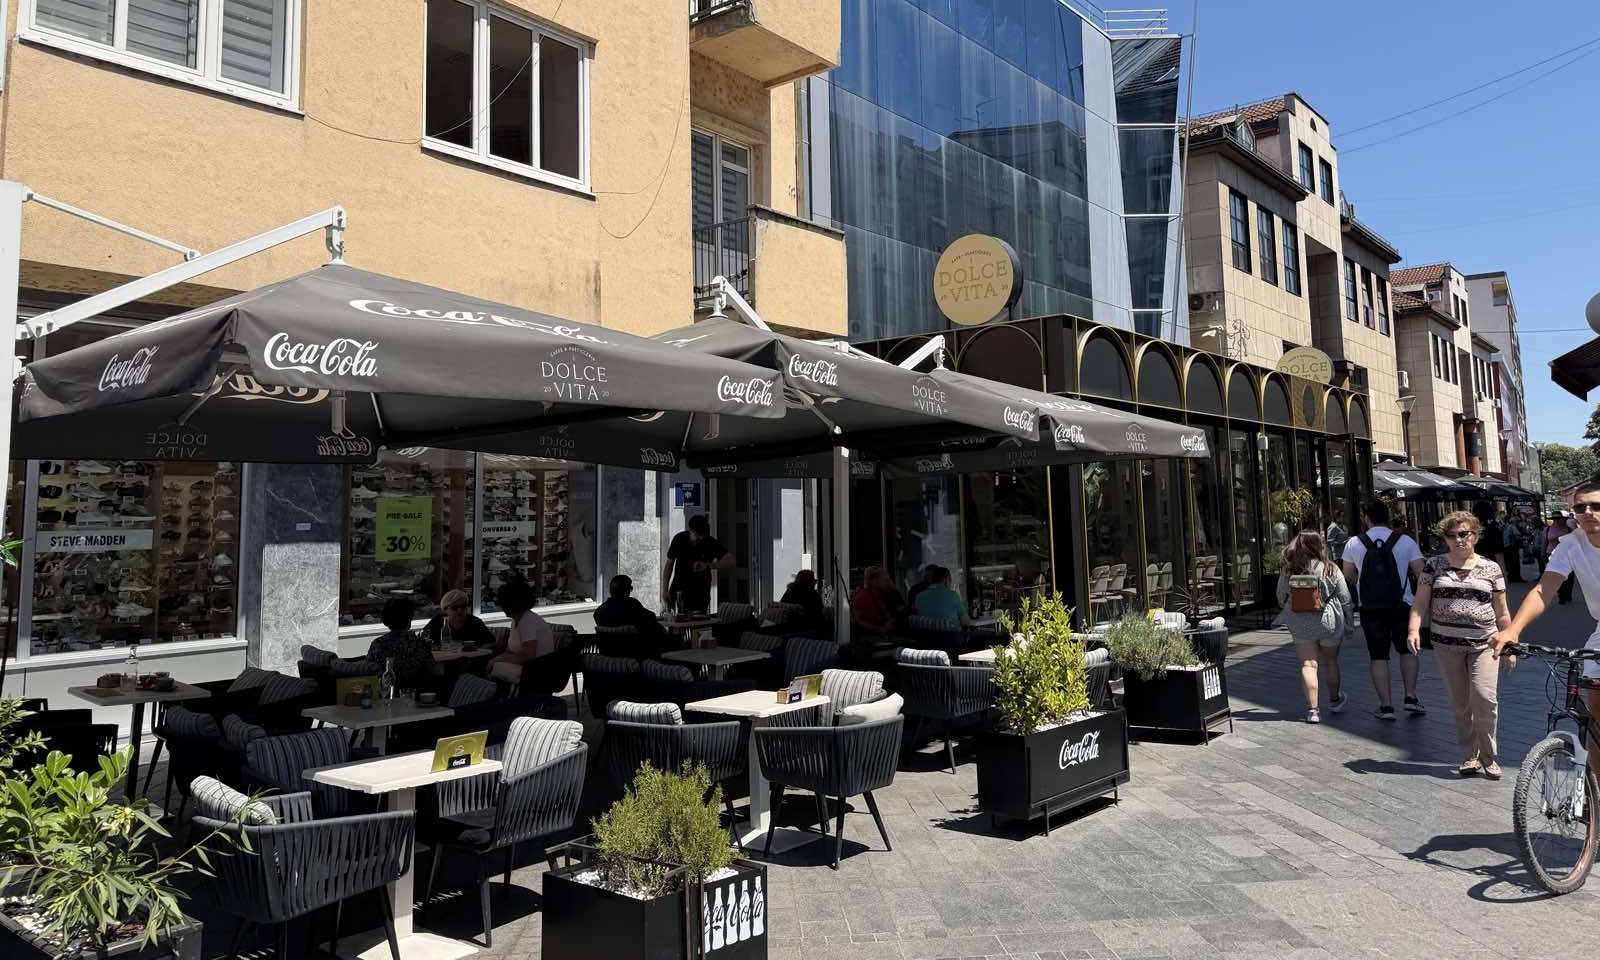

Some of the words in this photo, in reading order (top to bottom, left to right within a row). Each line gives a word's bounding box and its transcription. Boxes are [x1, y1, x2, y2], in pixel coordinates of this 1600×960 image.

[939, 260, 1008, 287] DOLCE
[950, 282, 998, 302] VITA
[263, 332, 379, 378] Coca-Cola
[98, 345, 160, 392] Coca-Cola
[541, 361, 608, 383] DOLCE
[788, 353, 839, 387] Coca-Cola
[553, 382, 599, 400] VITA
[717, 375, 774, 408] Coca-Cola
[912, 385, 947, 403] DOLCE
[918, 399, 943, 415] VITA
[1003, 406, 1036, 432] Coca-Cola
[1055, 423, 1086, 444] Coca-Cola
[1125, 431, 1147, 442] DOLCE
[1180, 433, 1206, 452] Coca-Cola
[50, 536, 81, 547] STEVE
[85, 535, 126, 546] MADDEN
[1058, 729, 1100, 770] Coca-Cola
